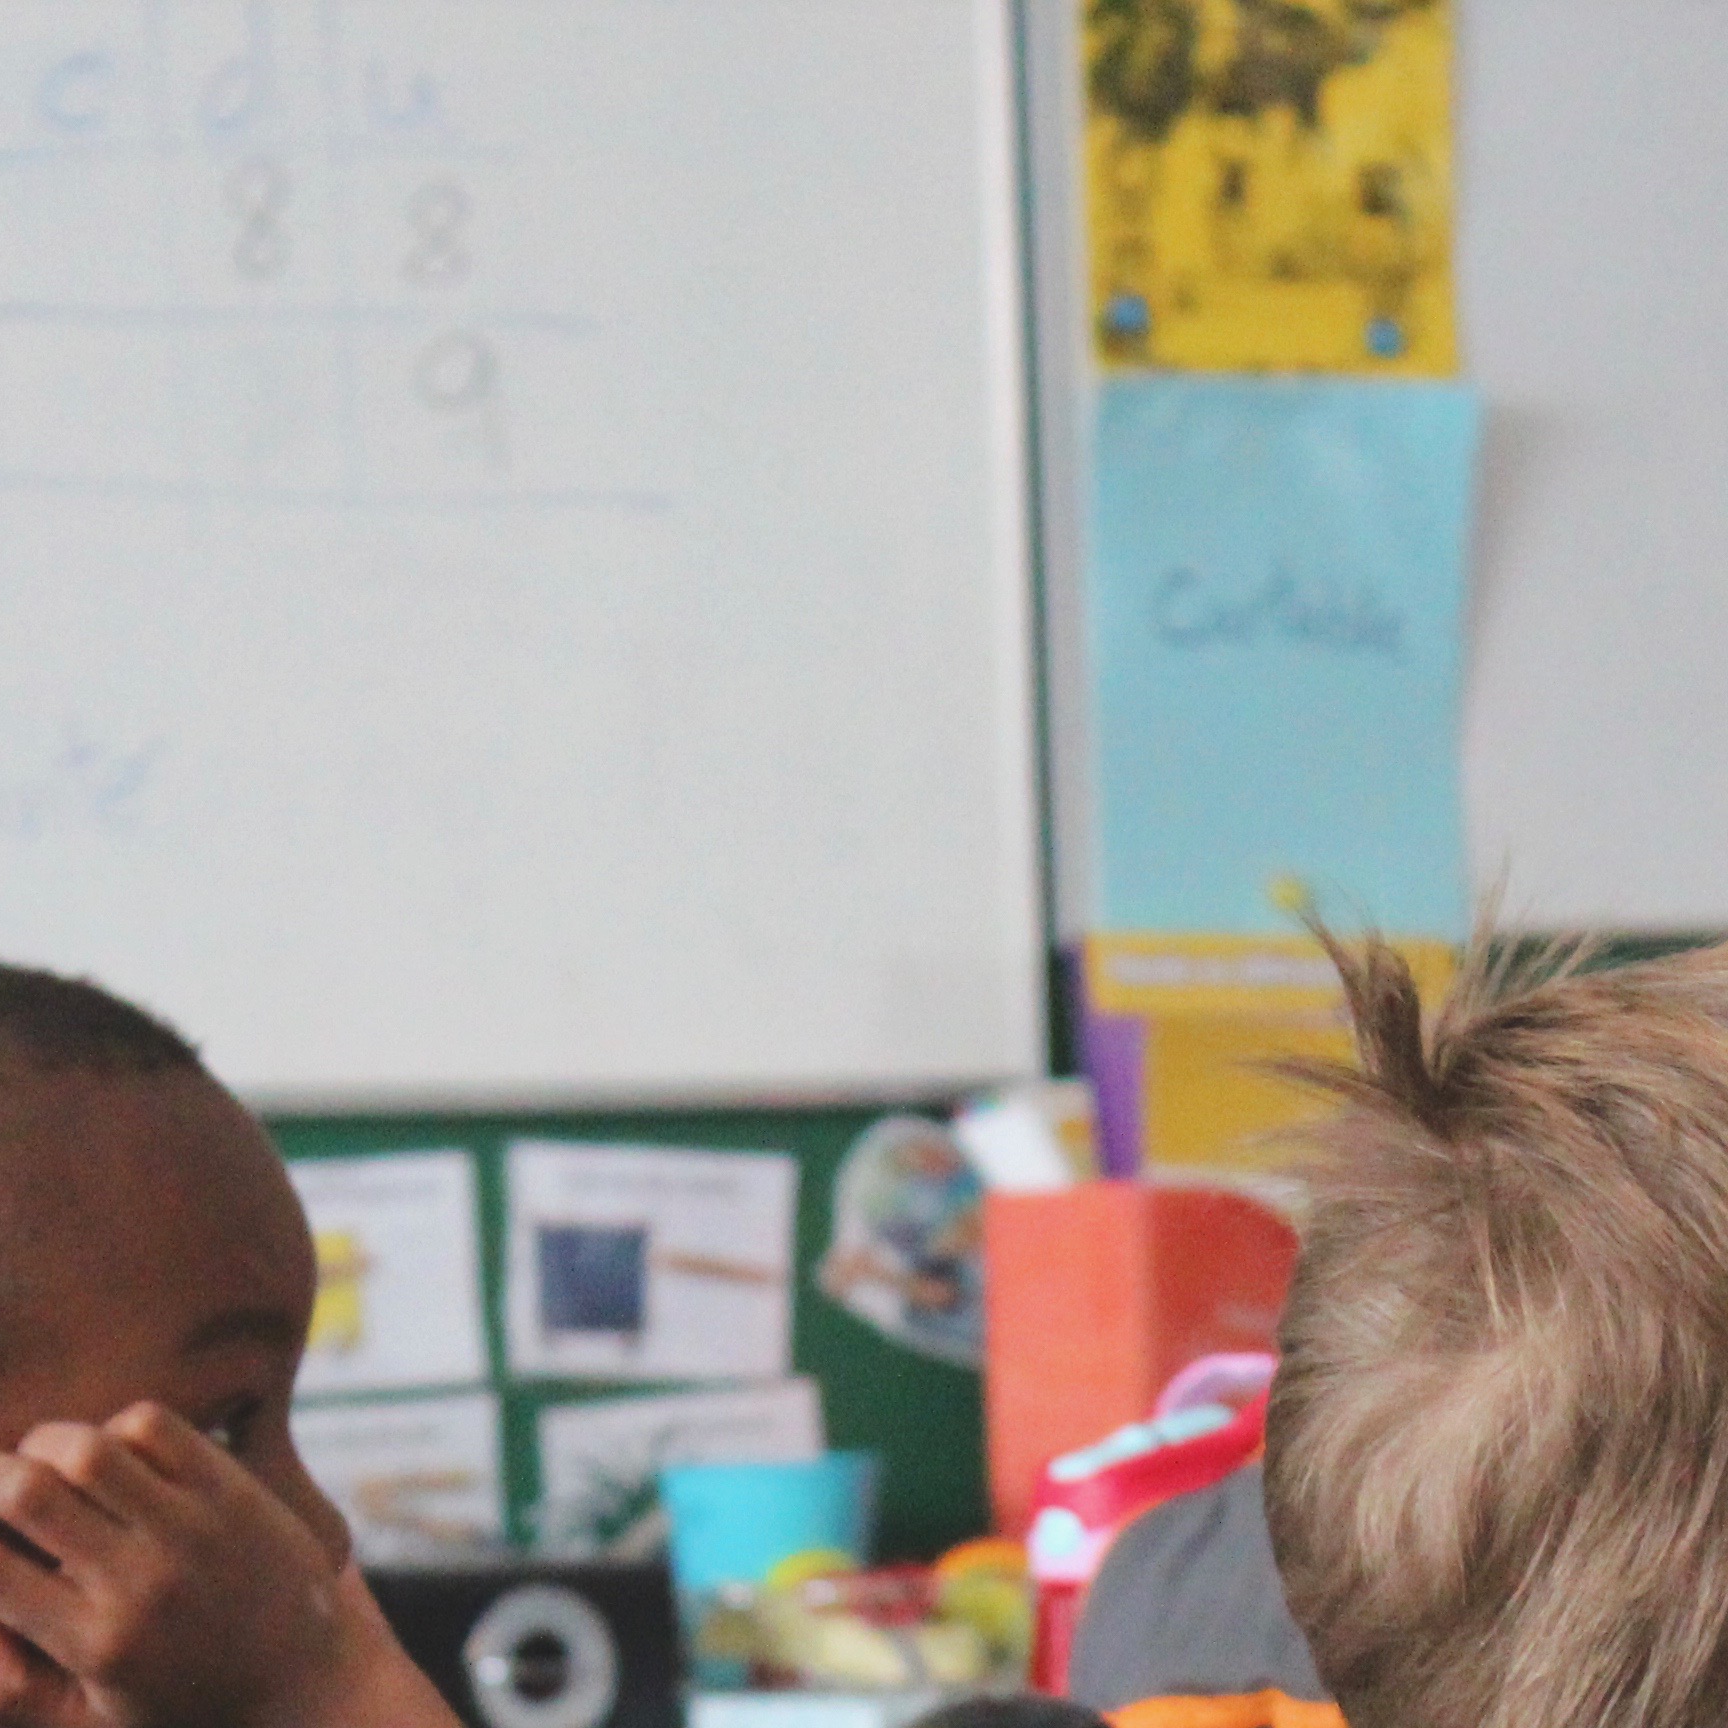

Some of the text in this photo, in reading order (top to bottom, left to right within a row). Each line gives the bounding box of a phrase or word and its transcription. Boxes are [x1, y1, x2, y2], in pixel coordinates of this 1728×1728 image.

[225, 150, 474, 289] 8 8
[410, 326, 514, 474] 9
